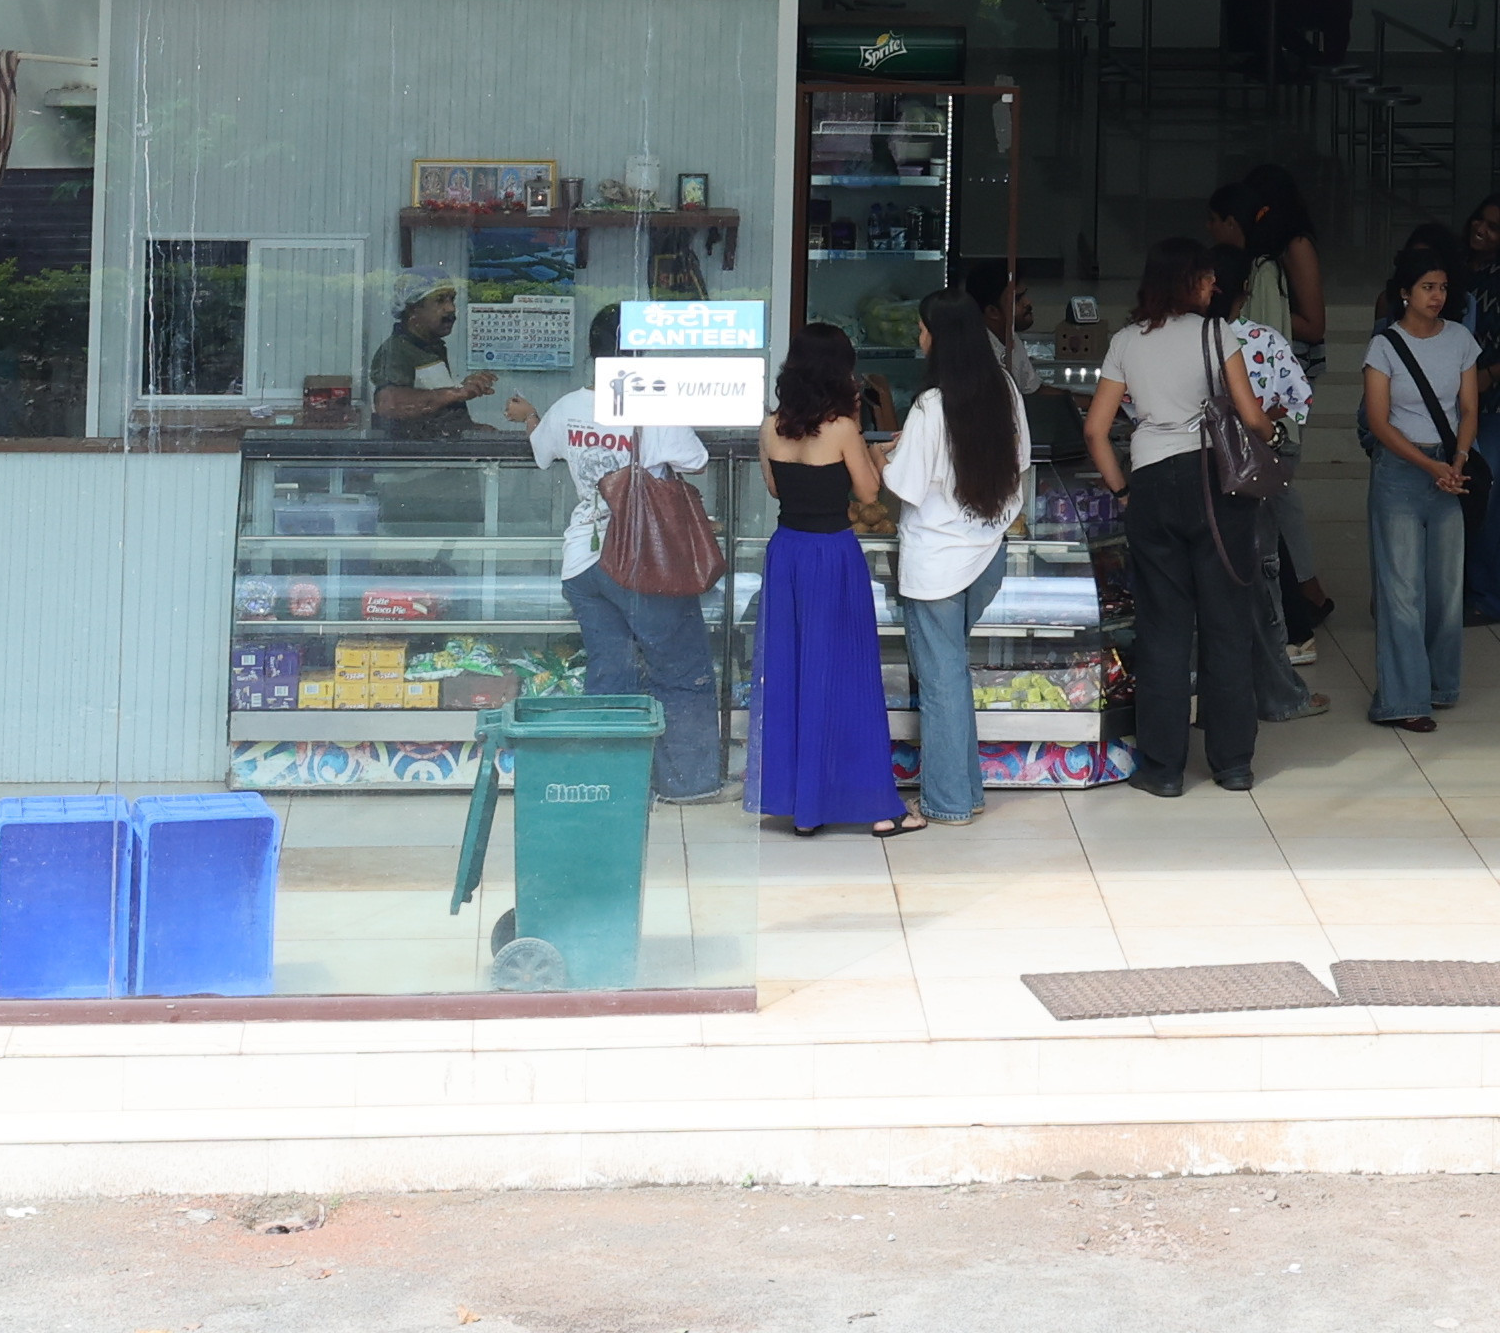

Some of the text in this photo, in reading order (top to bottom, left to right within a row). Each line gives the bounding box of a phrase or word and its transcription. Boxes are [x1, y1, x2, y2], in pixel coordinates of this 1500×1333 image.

[864, 39, 901, 68] Sprite
[642, 303, 738, 327] कैंटीन
[627, 328, 757, 347] CANTEEN
[677, 381, 746, 397] YUMTUM
[568, 429, 633, 452] MOON
